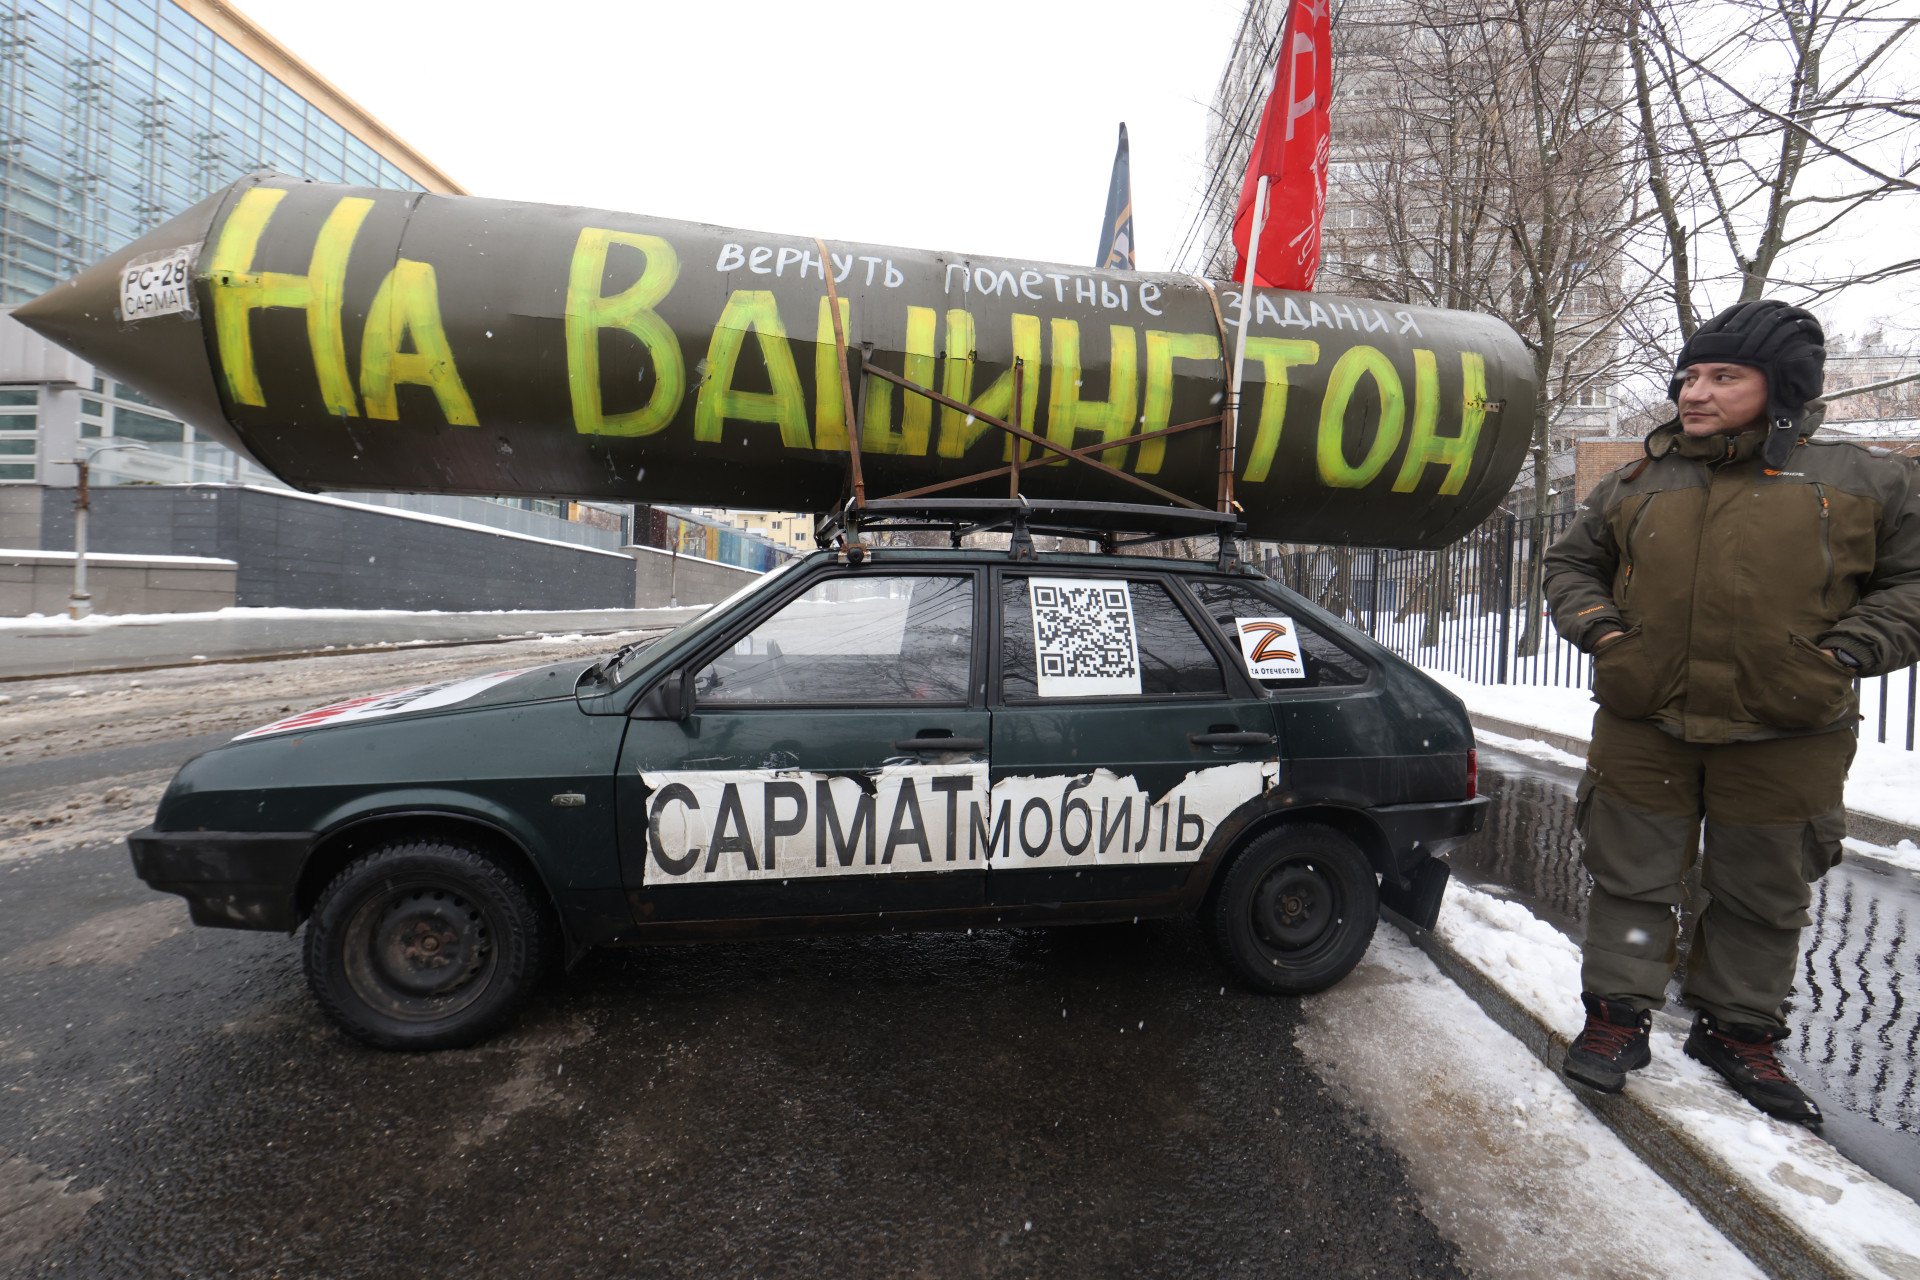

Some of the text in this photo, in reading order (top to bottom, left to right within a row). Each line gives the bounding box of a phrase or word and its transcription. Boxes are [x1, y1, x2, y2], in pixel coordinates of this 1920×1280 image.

[125, 258, 187, 293] РС-28
[125, 287, 185, 315] САРМАТ
[210, 187, 1488, 495] НА ВАШИНГТОН
